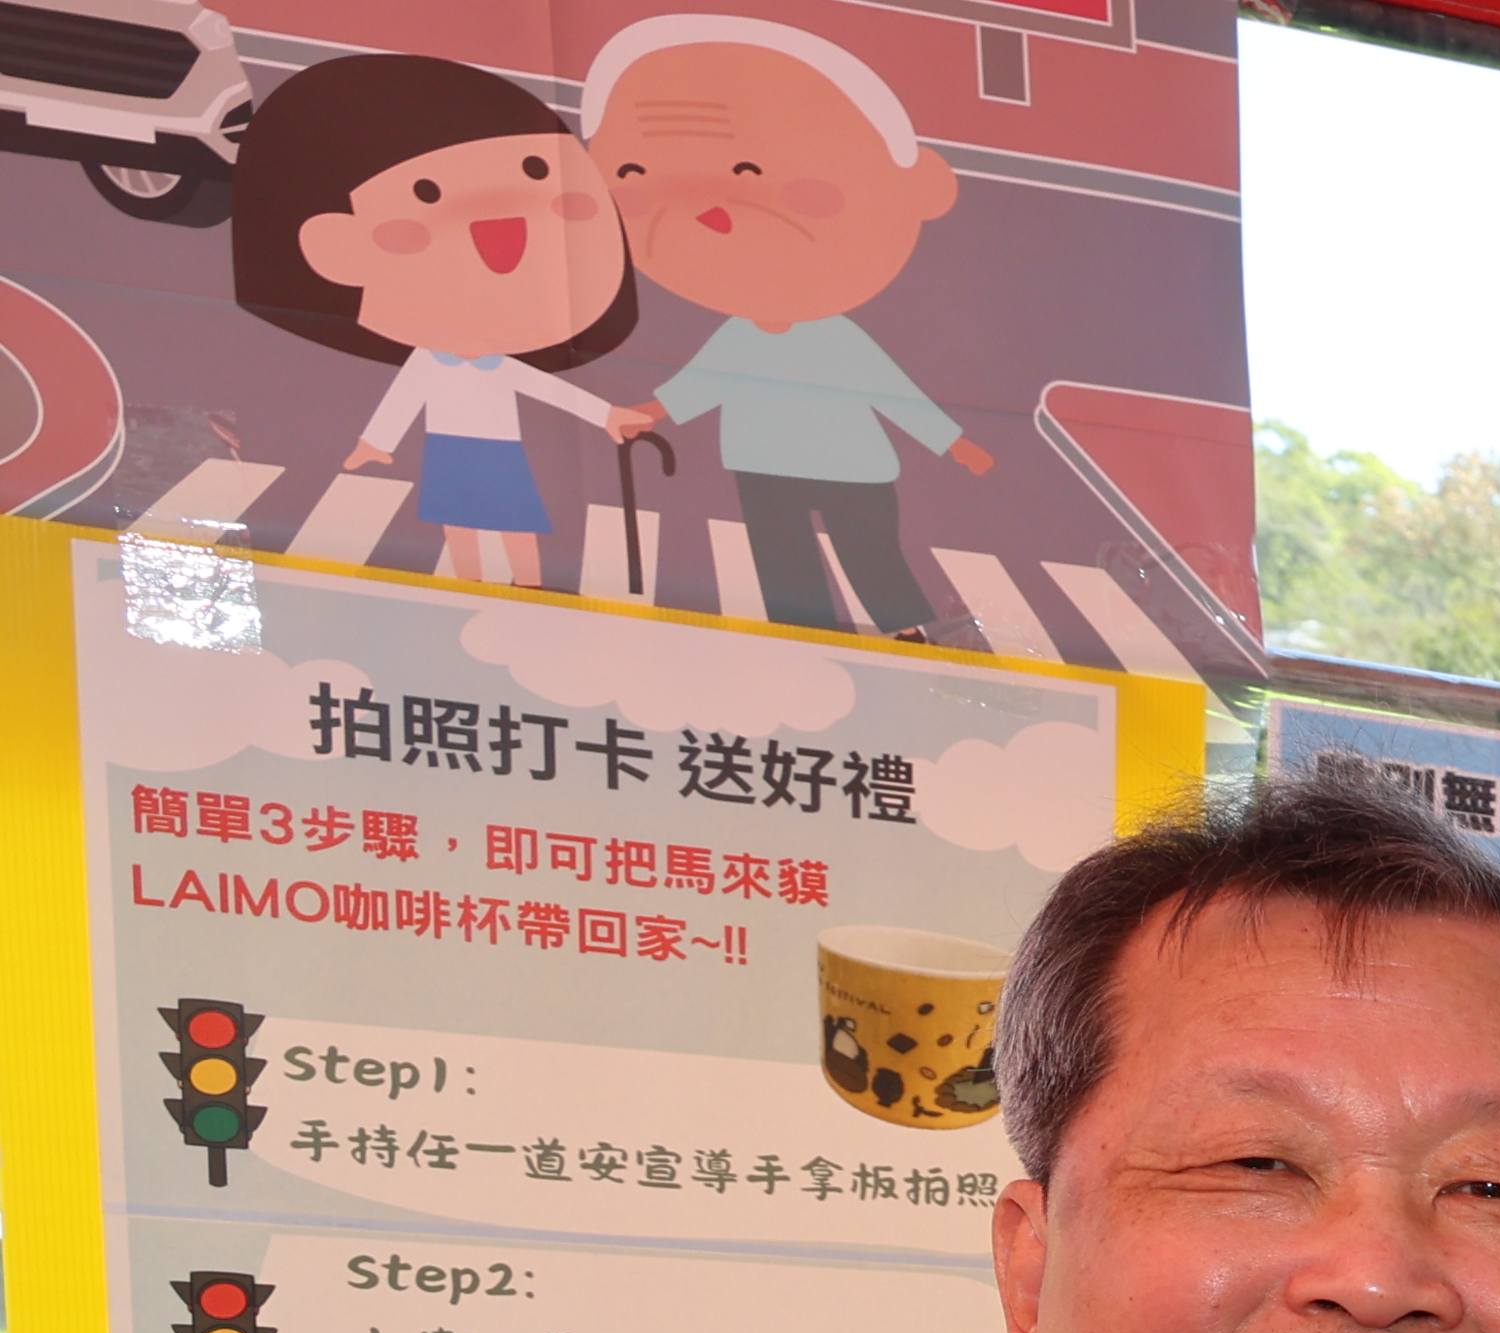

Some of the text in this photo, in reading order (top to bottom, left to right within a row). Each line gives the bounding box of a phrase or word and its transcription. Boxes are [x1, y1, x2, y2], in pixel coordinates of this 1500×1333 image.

[311, 684, 917, 826] 拍照打卡 送好禮
[282, 1046, 479, 1099] Step1:
[347, 1254, 536, 1304] Step2:
